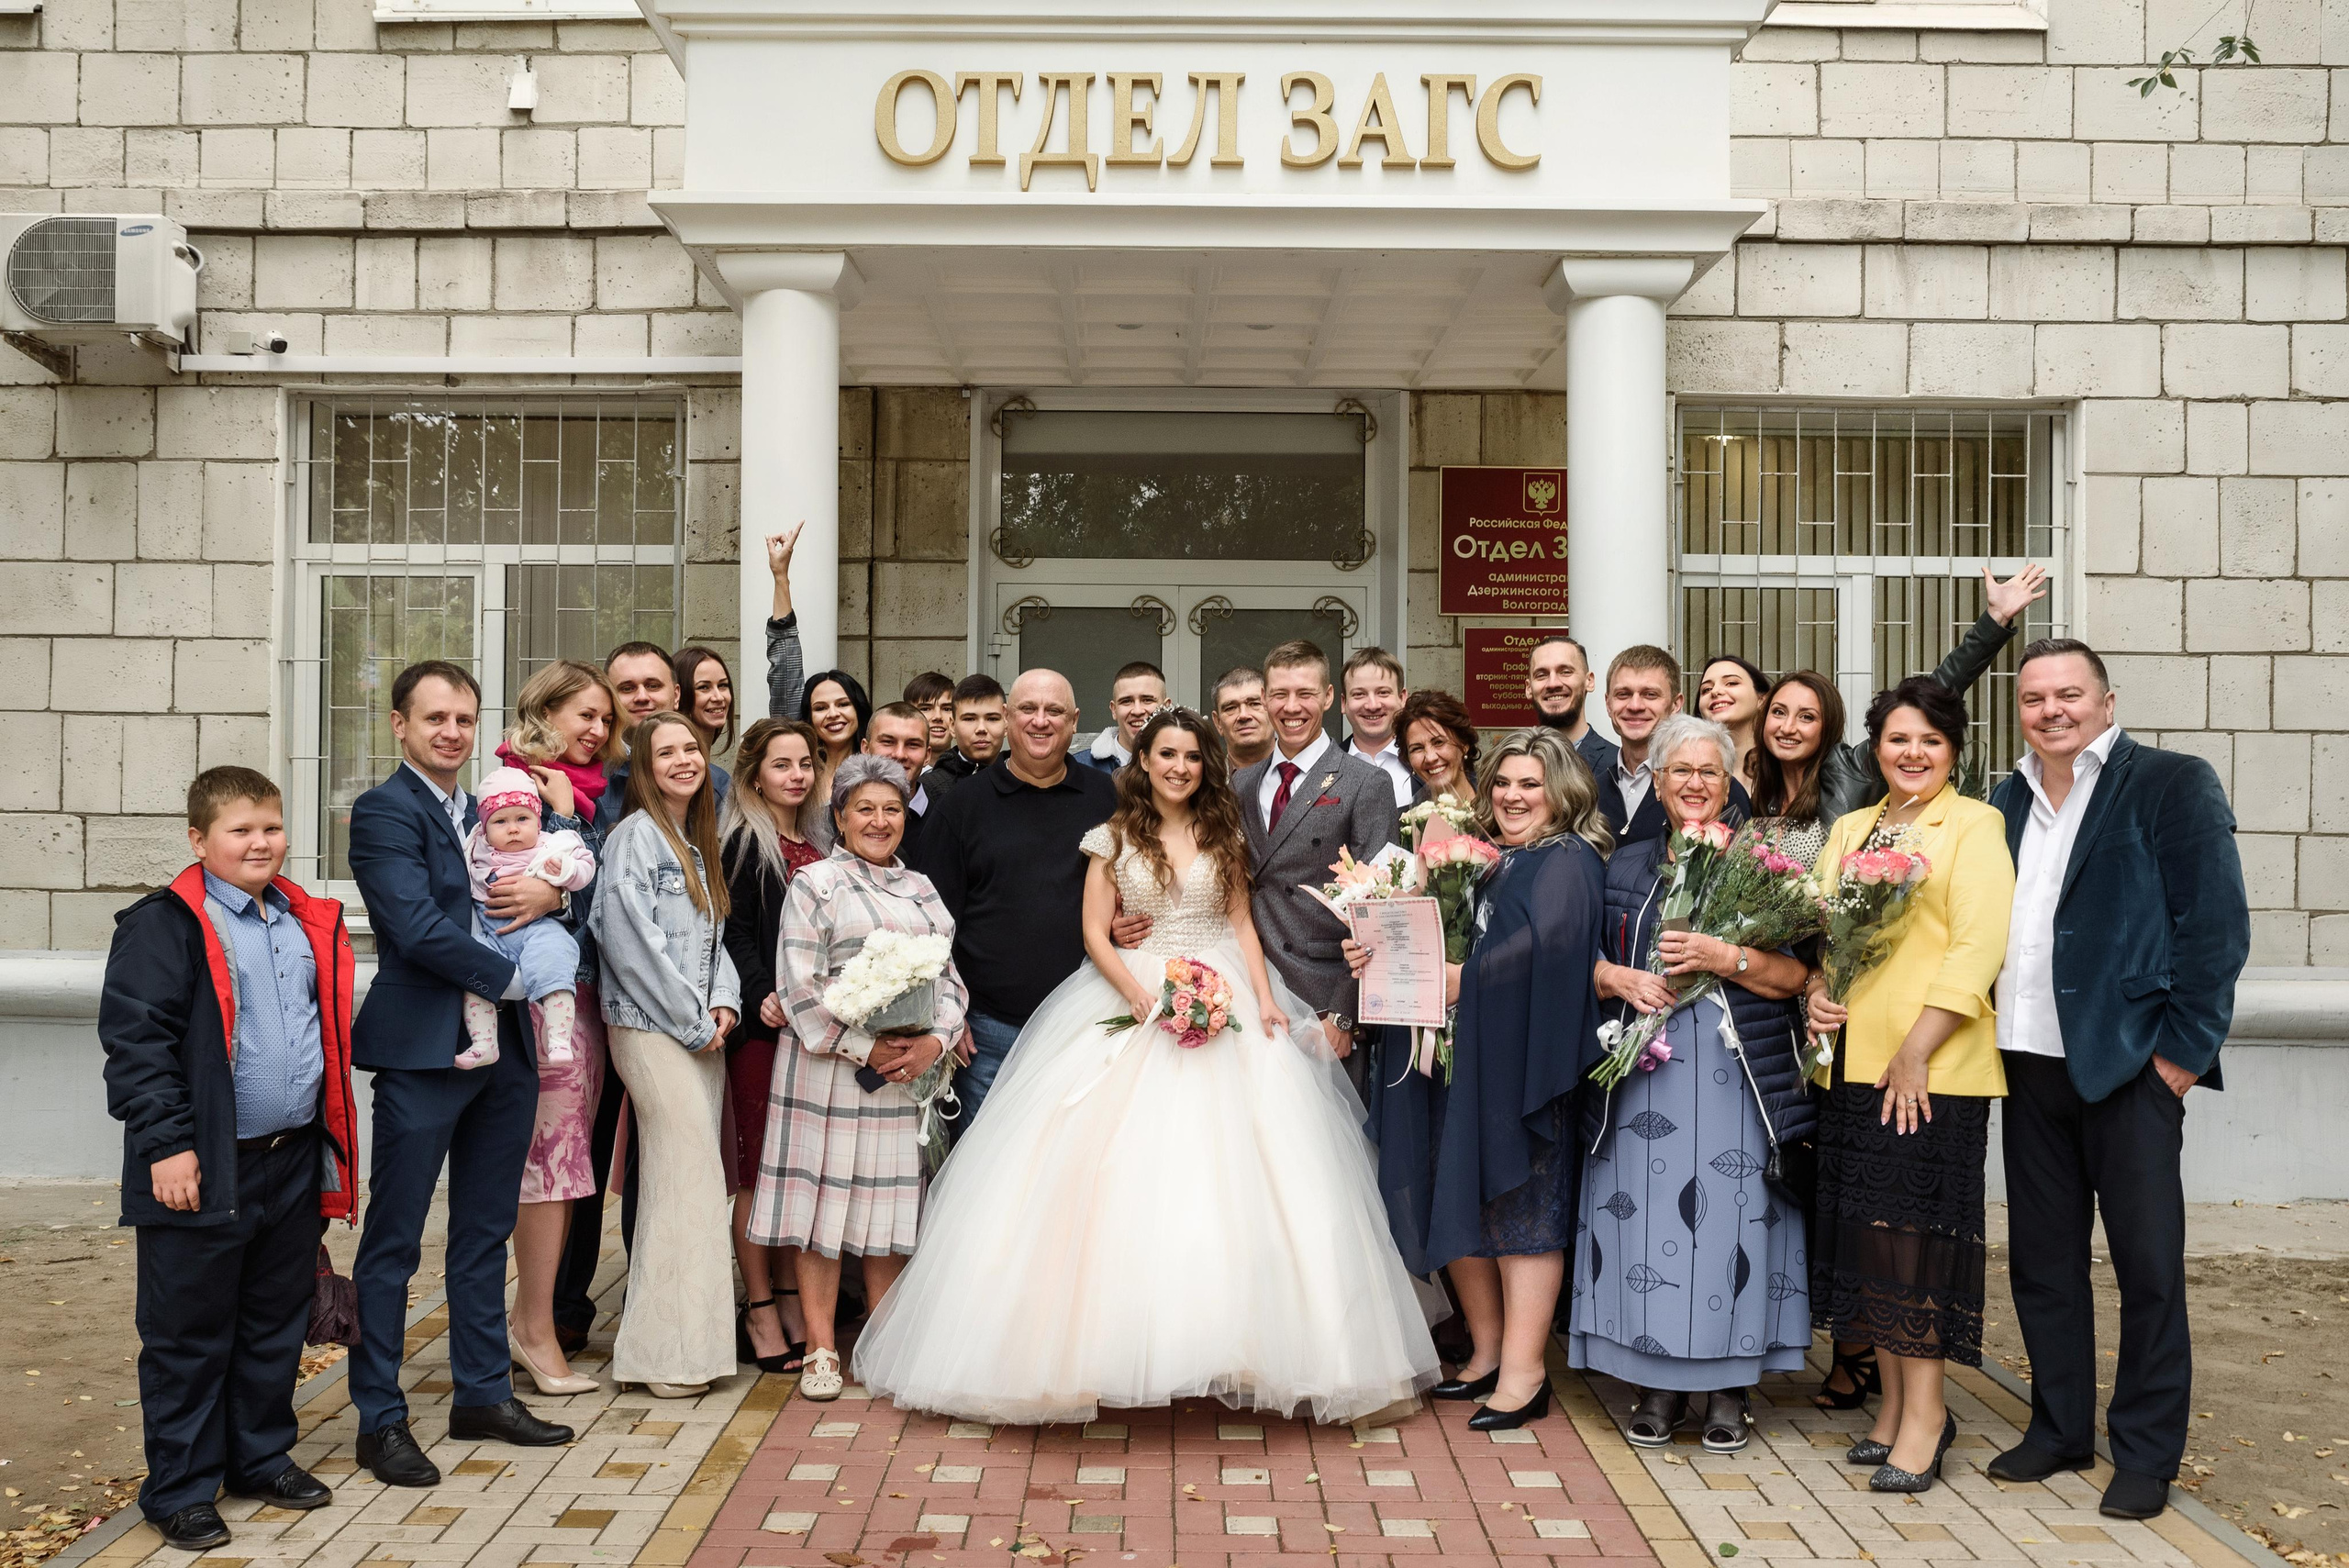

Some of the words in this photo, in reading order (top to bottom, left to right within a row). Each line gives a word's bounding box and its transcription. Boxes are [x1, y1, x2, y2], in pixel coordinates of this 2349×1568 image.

[874, 69, 1247, 192] ОТДЕЛ
[1281, 71, 1544, 171] ЗАГС
[1469, 517, 1541, 529] Российская
[1453, 534, 1545, 562] Отдел
[1488, 573, 1568, 584] администра
[1467, 584, 1560, 597] Дзержинского
[1502, 599, 1568, 612] Волгоград
[1504, 635, 1541, 647] Отдел
[1489, 683, 1526, 691] перерыв
